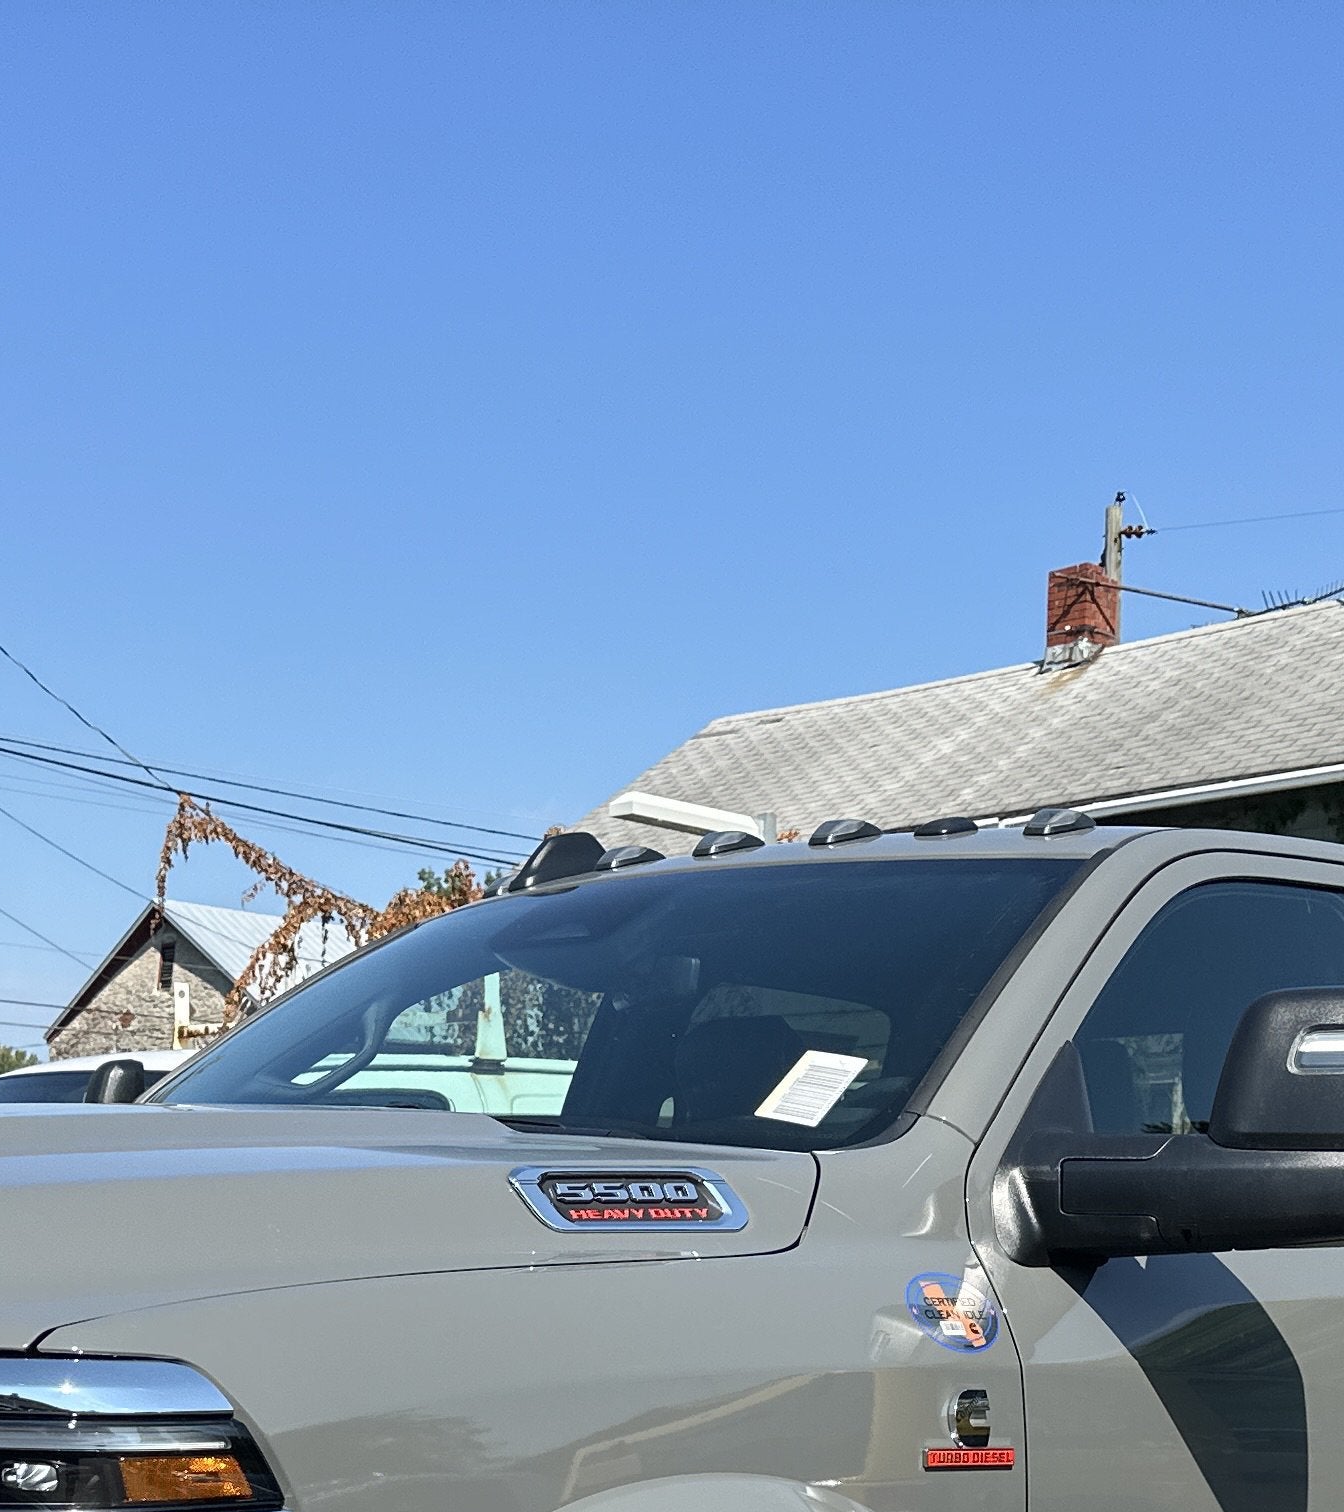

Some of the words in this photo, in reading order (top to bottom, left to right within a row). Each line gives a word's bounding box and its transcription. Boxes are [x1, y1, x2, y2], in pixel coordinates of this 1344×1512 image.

[556, 1182, 699, 1204] 5500
[569, 1208, 644, 1220] HEAVY
[648, 1208, 709, 1219] DUTY
[923, 1297, 976, 1307] CERTIFED
[924, 1309, 961, 1320] CLEAN
[929, 1452, 970, 1463] TURBO
[972, 1452, 1013, 1463] DIESEL
